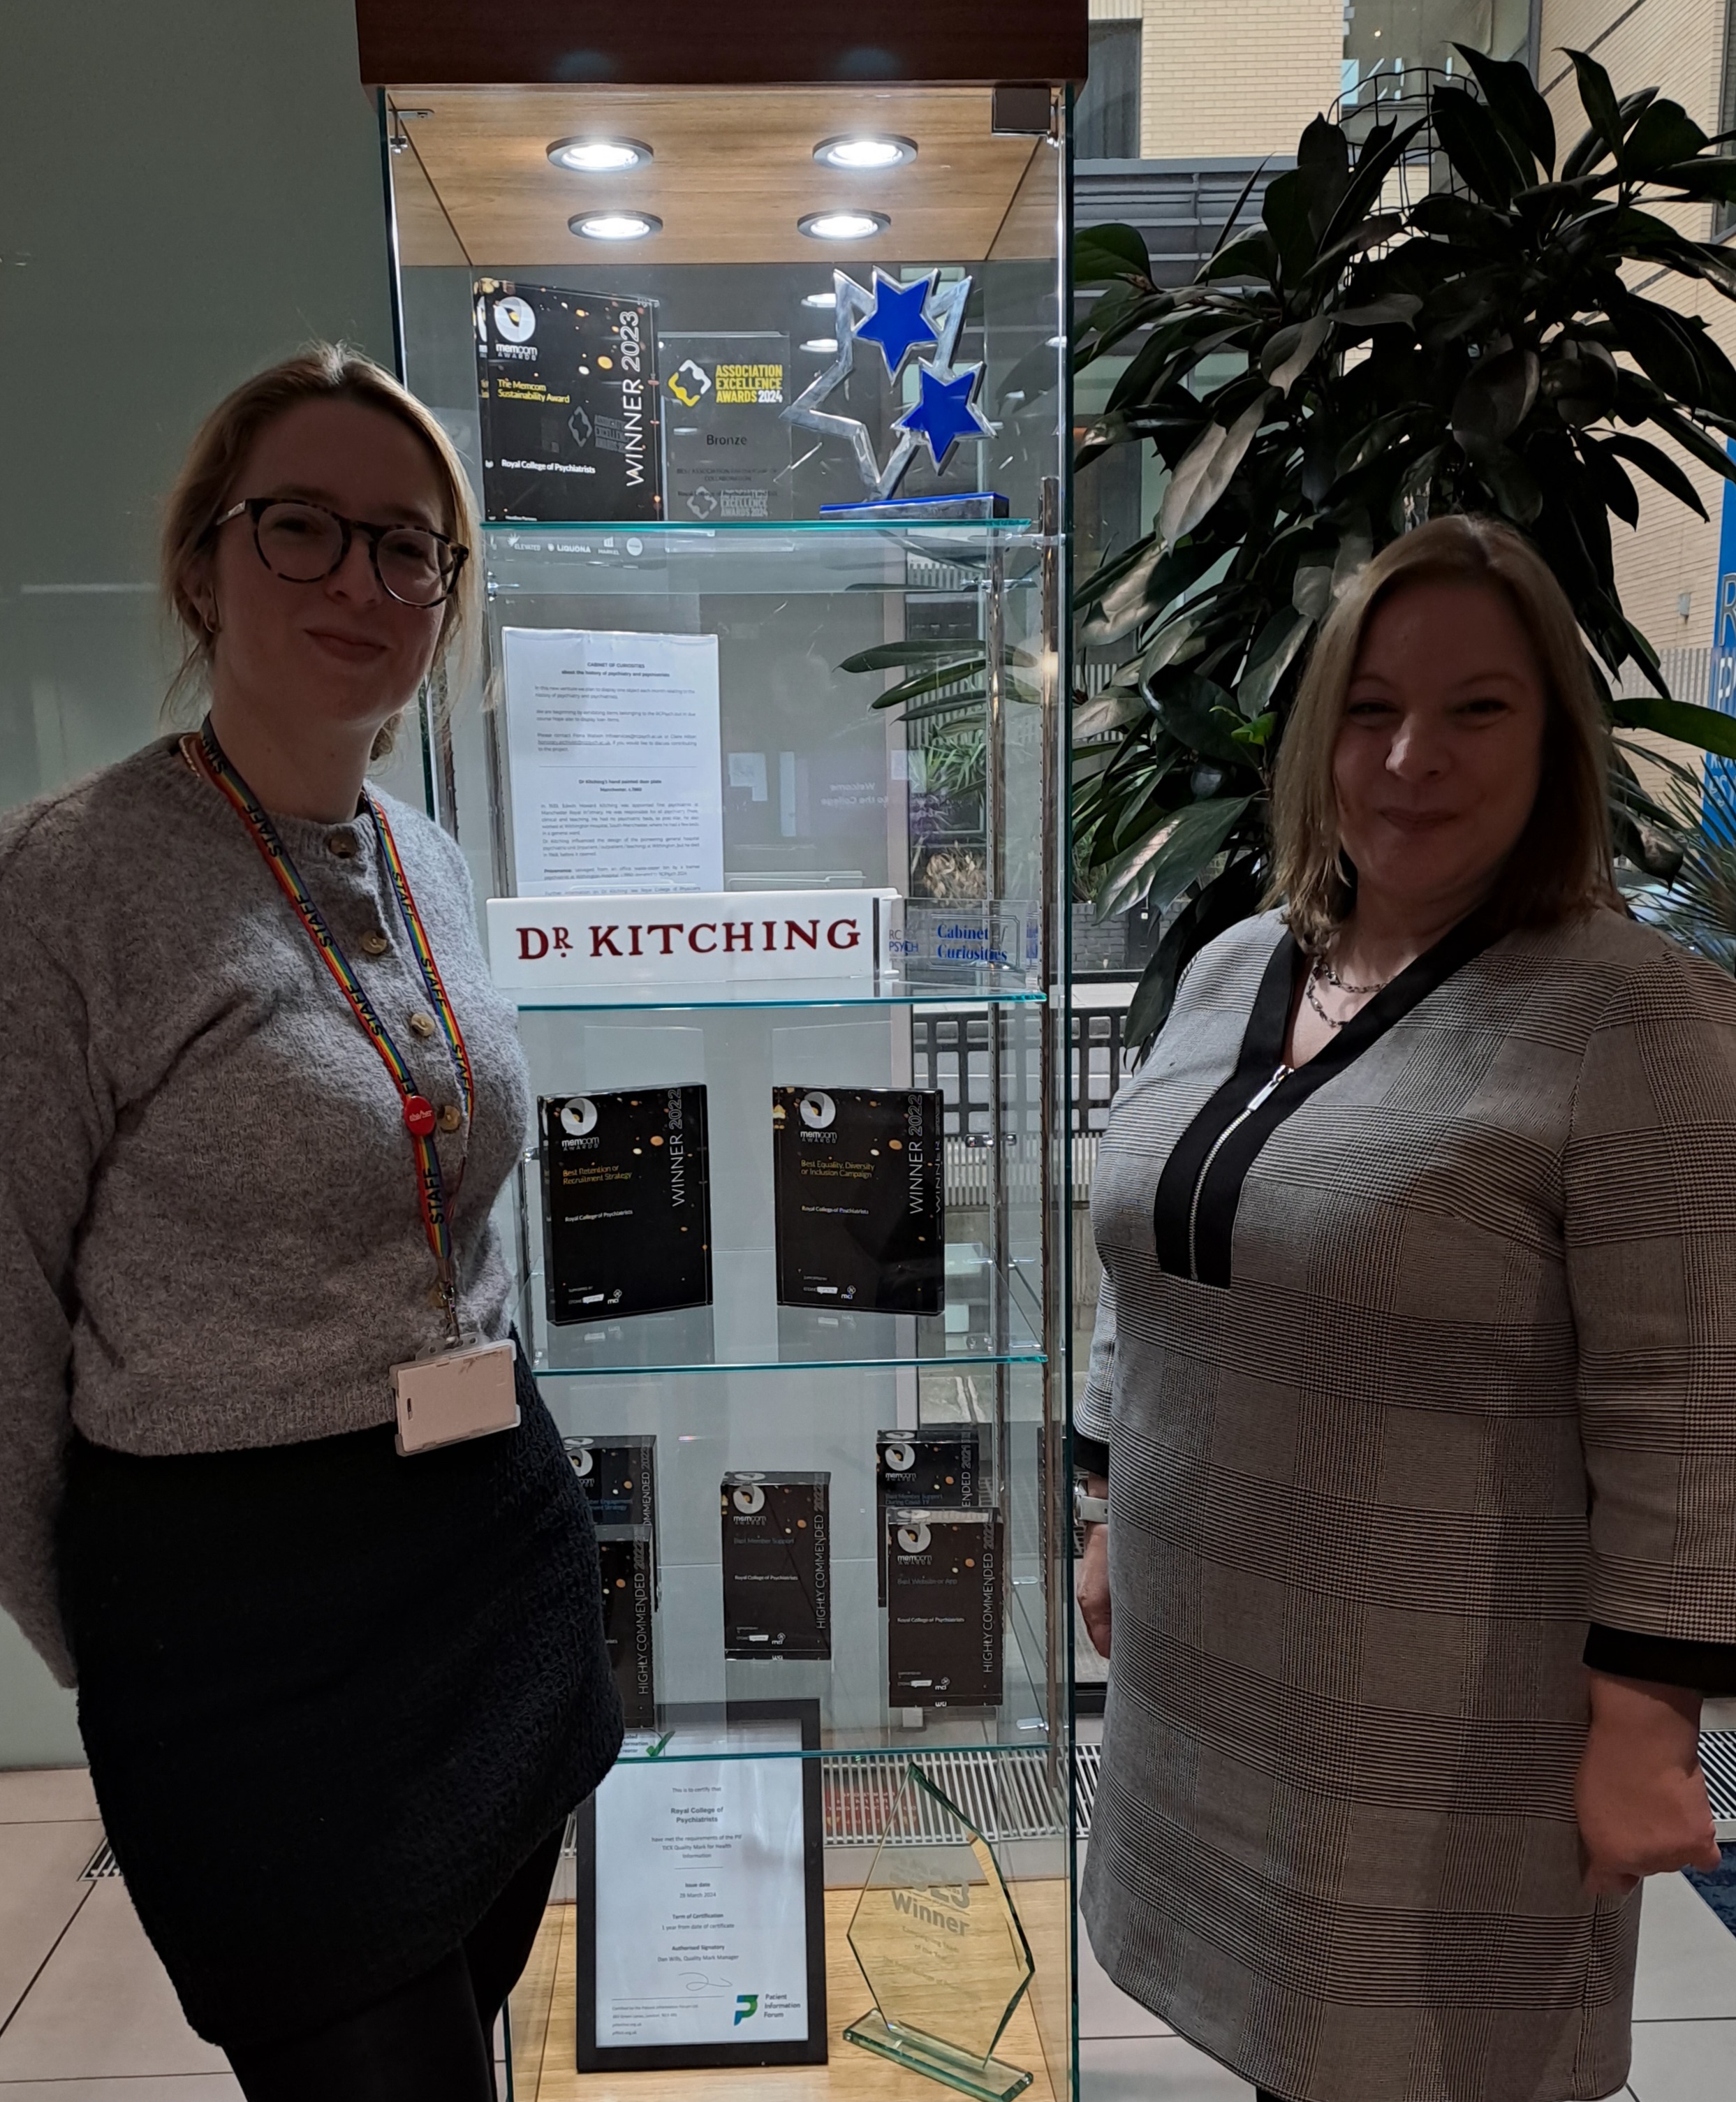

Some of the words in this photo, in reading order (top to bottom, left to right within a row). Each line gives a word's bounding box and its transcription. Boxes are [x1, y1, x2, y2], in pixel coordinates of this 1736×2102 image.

[496, 344, 538, 355] memcom
[620, 310, 640, 372] 2023
[498, 352, 536, 361] AWARDS
[497, 379, 511, 388] The
[513, 381, 546, 391] Memcom
[716, 365, 783, 377] ASSOCIATION
[716, 377, 782, 390] EXCELLENCE
[498, 389, 545, 402] Sustainability
[547, 393, 570, 403] Award
[716, 390, 757, 403] AWARDS
[758, 390, 783, 403] 2024
[623, 378, 644, 486] WINNER
[706, 434, 747, 446] Bronze
[501, 459, 520, 469] Royal
[521, 461, 546, 471] College
[554, 463, 596, 473] Psychiatrists
[557, 544, 591, 553] LIQUONA
[242, 804, 284, 858] STAFF
[391, 870, 418, 923] STAFF
[293, 893, 334, 948] STAFF
[889, 929, 902, 939] RC
[937, 924, 989, 940] Cabinet
[589, 919, 860, 957] KITCHING
[889, 941, 919, 953] PSYCH
[937, 944, 1008, 962] Curiosities
[420, 957, 447, 1009] STAFF
[344, 983, 384, 1038] STAFF
[668, 1088, 682, 1130] 2022
[908, 1094, 922, 1136] 2022
[561, 1137, 600, 1147] memcom
[800, 1131, 837, 1140] memcom
[563, 1174, 604, 1185] Recruitment
[579, 1166, 610, 1175] Retention
[670, 1134, 685, 1207] WINNER
[839, 1170, 871, 1179] Campaign
[845, 1161, 875, 1171] Diversity
[909, 1140, 924, 1214] WINNER
[422, 1167, 446, 1226] STAFF
[814, 1515, 827, 1589] COMMENDED
[983, 1552, 995, 1630] COMMENDED
[634, 1573, 648, 1652] COMMENDED
[816, 1591, 825, 1629] HIGHLY
[983, 1631, 993, 1673] HIGHLY
[638, 1653, 648, 1694] HIGHLY
[891, 1890, 970, 1936] Winner
